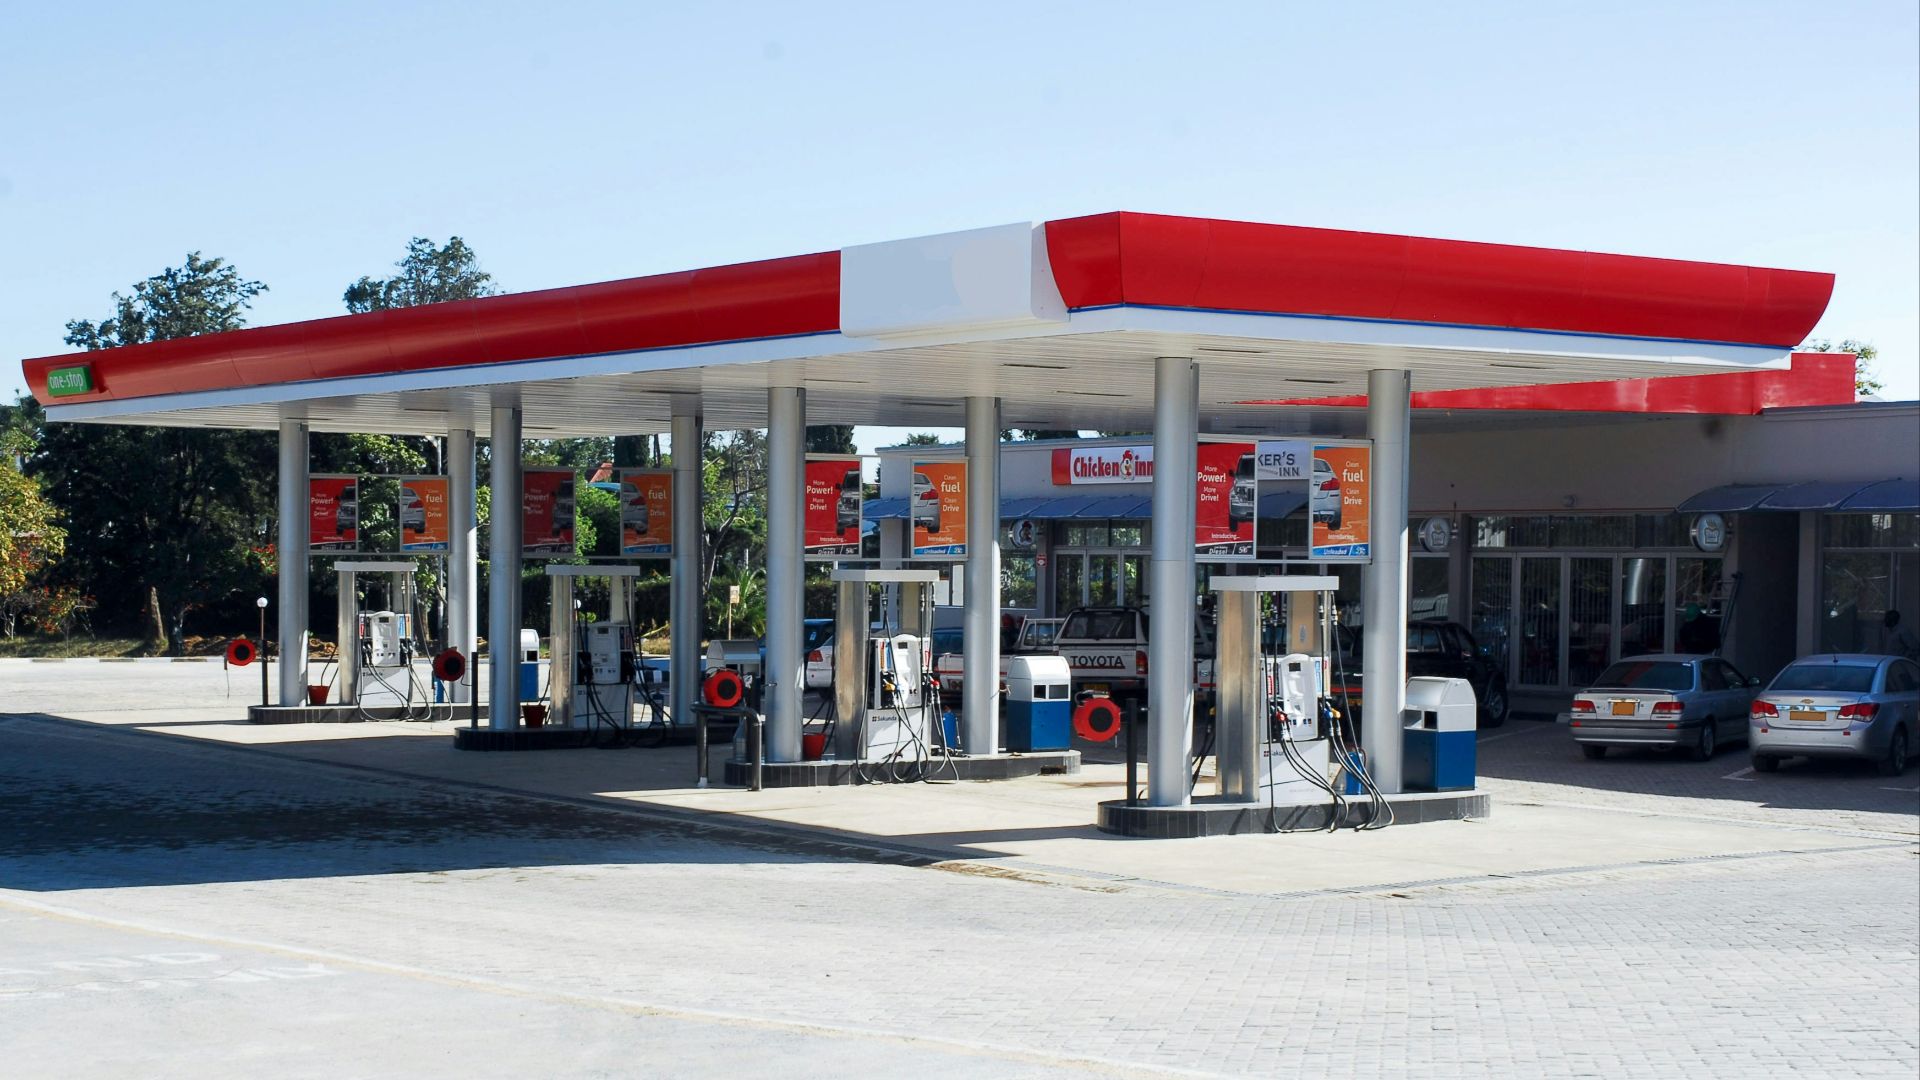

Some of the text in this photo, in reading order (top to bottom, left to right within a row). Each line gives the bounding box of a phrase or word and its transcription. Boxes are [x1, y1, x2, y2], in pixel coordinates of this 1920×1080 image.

[49, 371, 83, 391] one-stop
[1073, 455, 1120, 478] Chicken
[1345, 460, 1359, 468] Clean
[1278, 468, 1300, 477] INN
[1342, 469, 1364, 482] fuel
[1197, 473, 1227, 483] Power!
[806, 485, 833, 494] Power!
[940, 481, 960, 493] fuel
[1346, 487, 1359, 495] Clean
[425, 494, 443, 503] fuel
[648, 490, 666, 500] fuel
[1200, 494, 1219, 502] Drive!
[1344, 496, 1362, 505] Drive
[942, 504, 960, 512] Drive
[1070, 655, 1123, 667] TOYOTA
